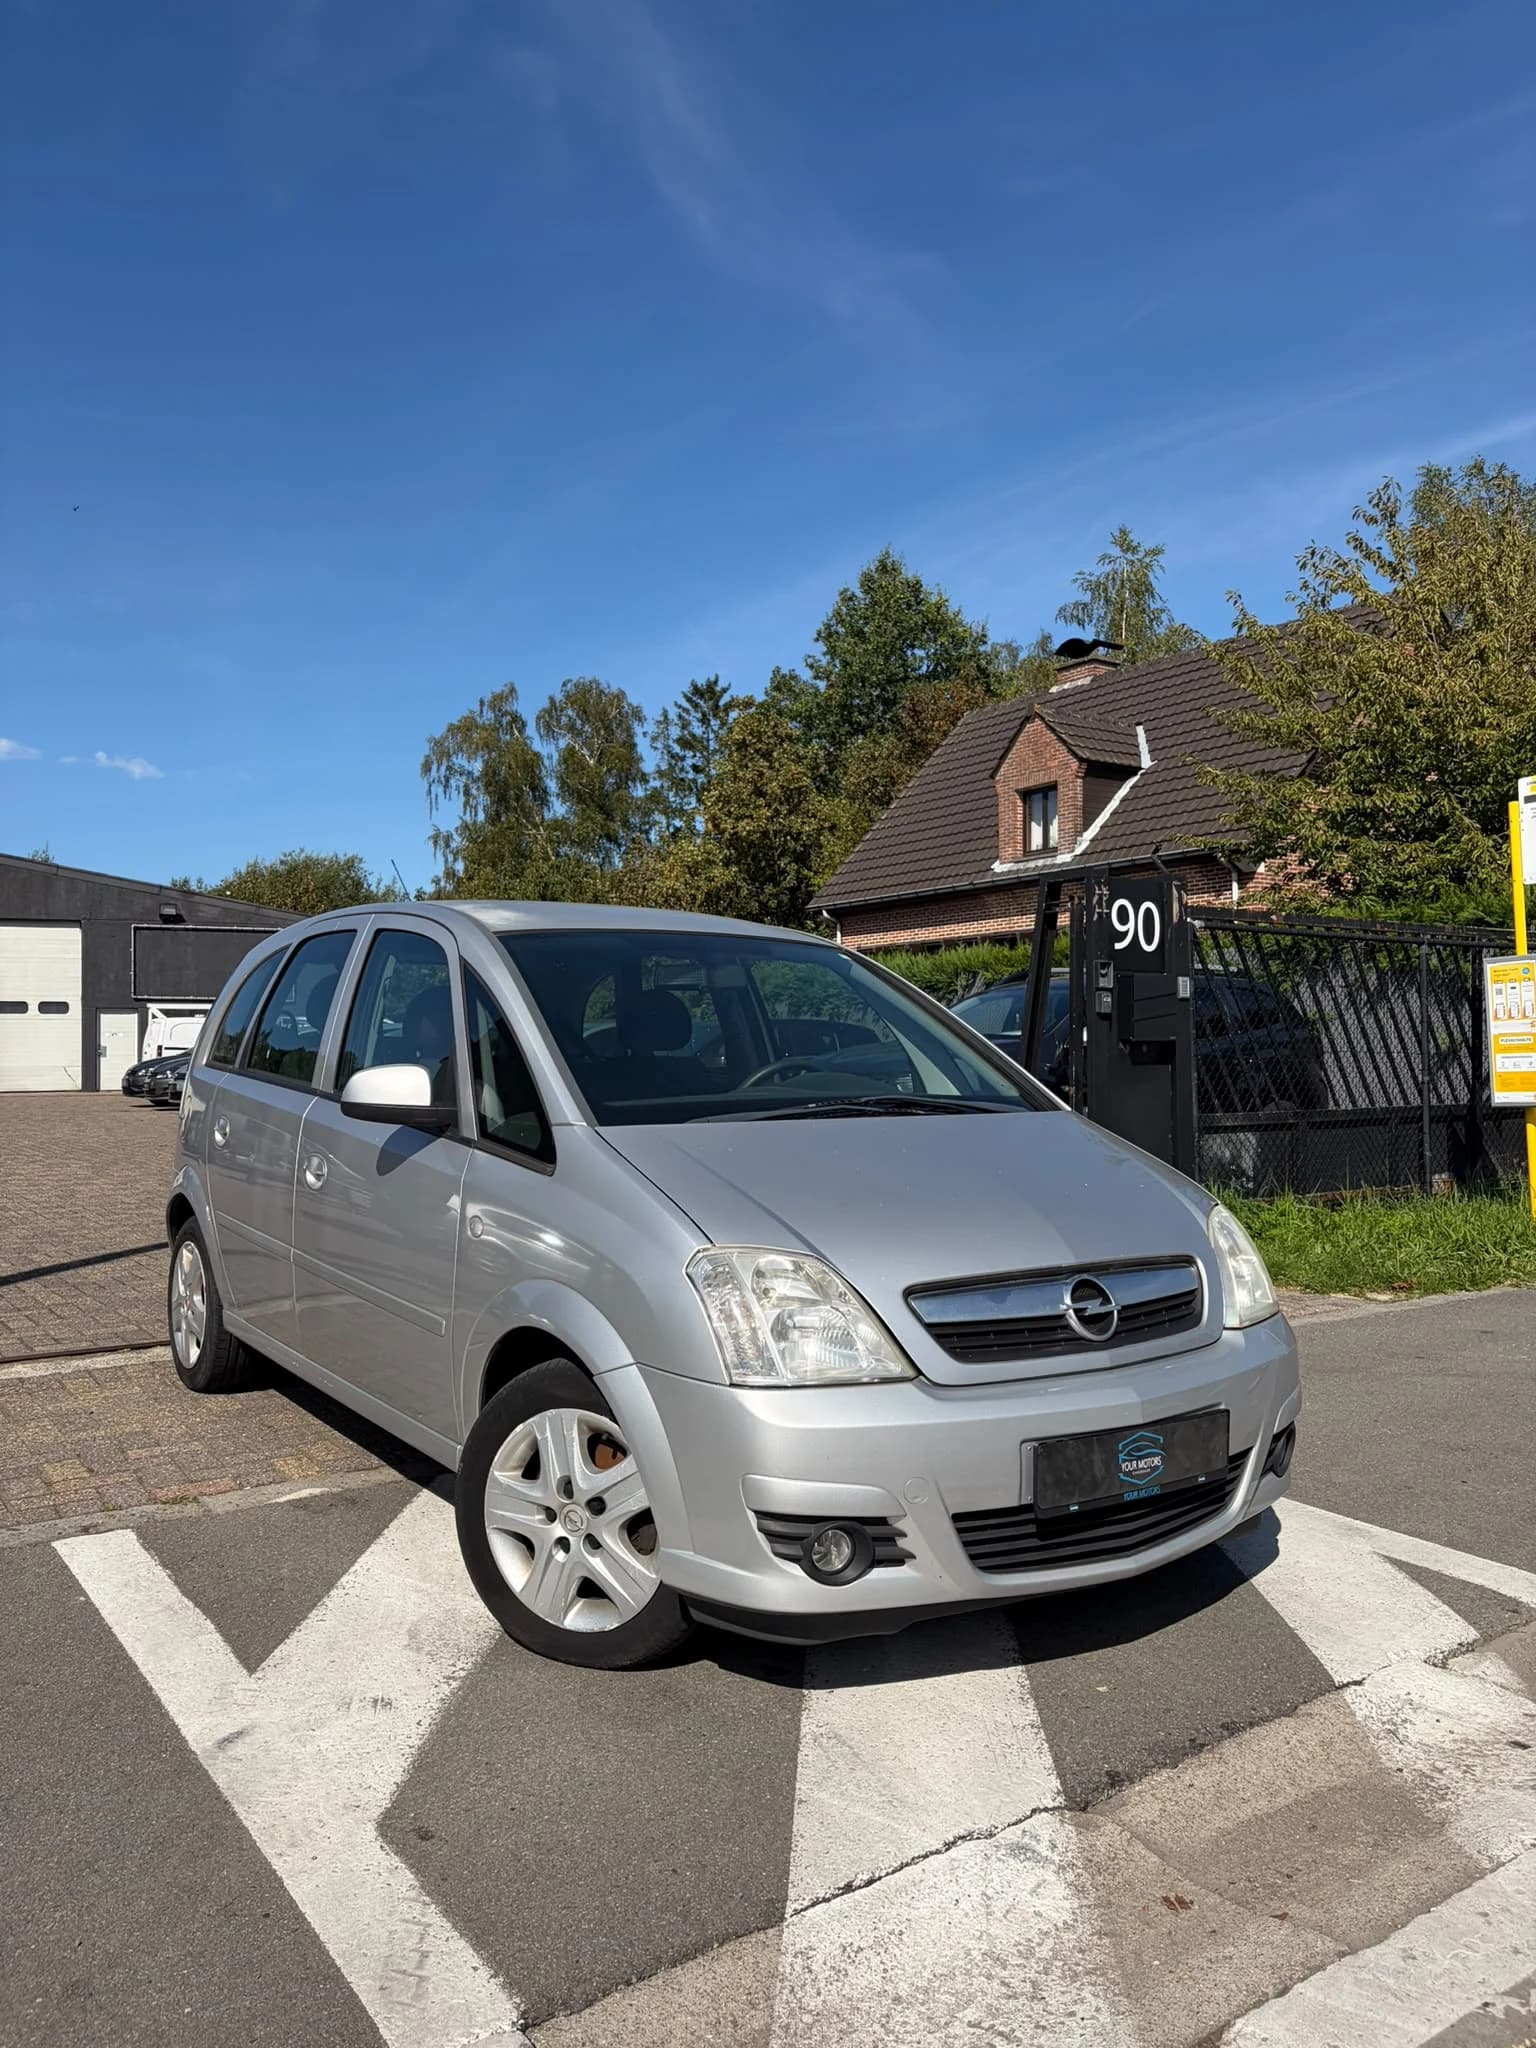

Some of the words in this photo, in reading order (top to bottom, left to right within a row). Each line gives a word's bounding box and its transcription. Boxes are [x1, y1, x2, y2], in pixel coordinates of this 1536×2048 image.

[1111, 898, 1160, 952] 90
[1121, 1461, 1137, 1472] YOUR
[1138, 1456, 1161, 1469] MOTORS
[1137, 1487, 1160, 1497] MOTORS
